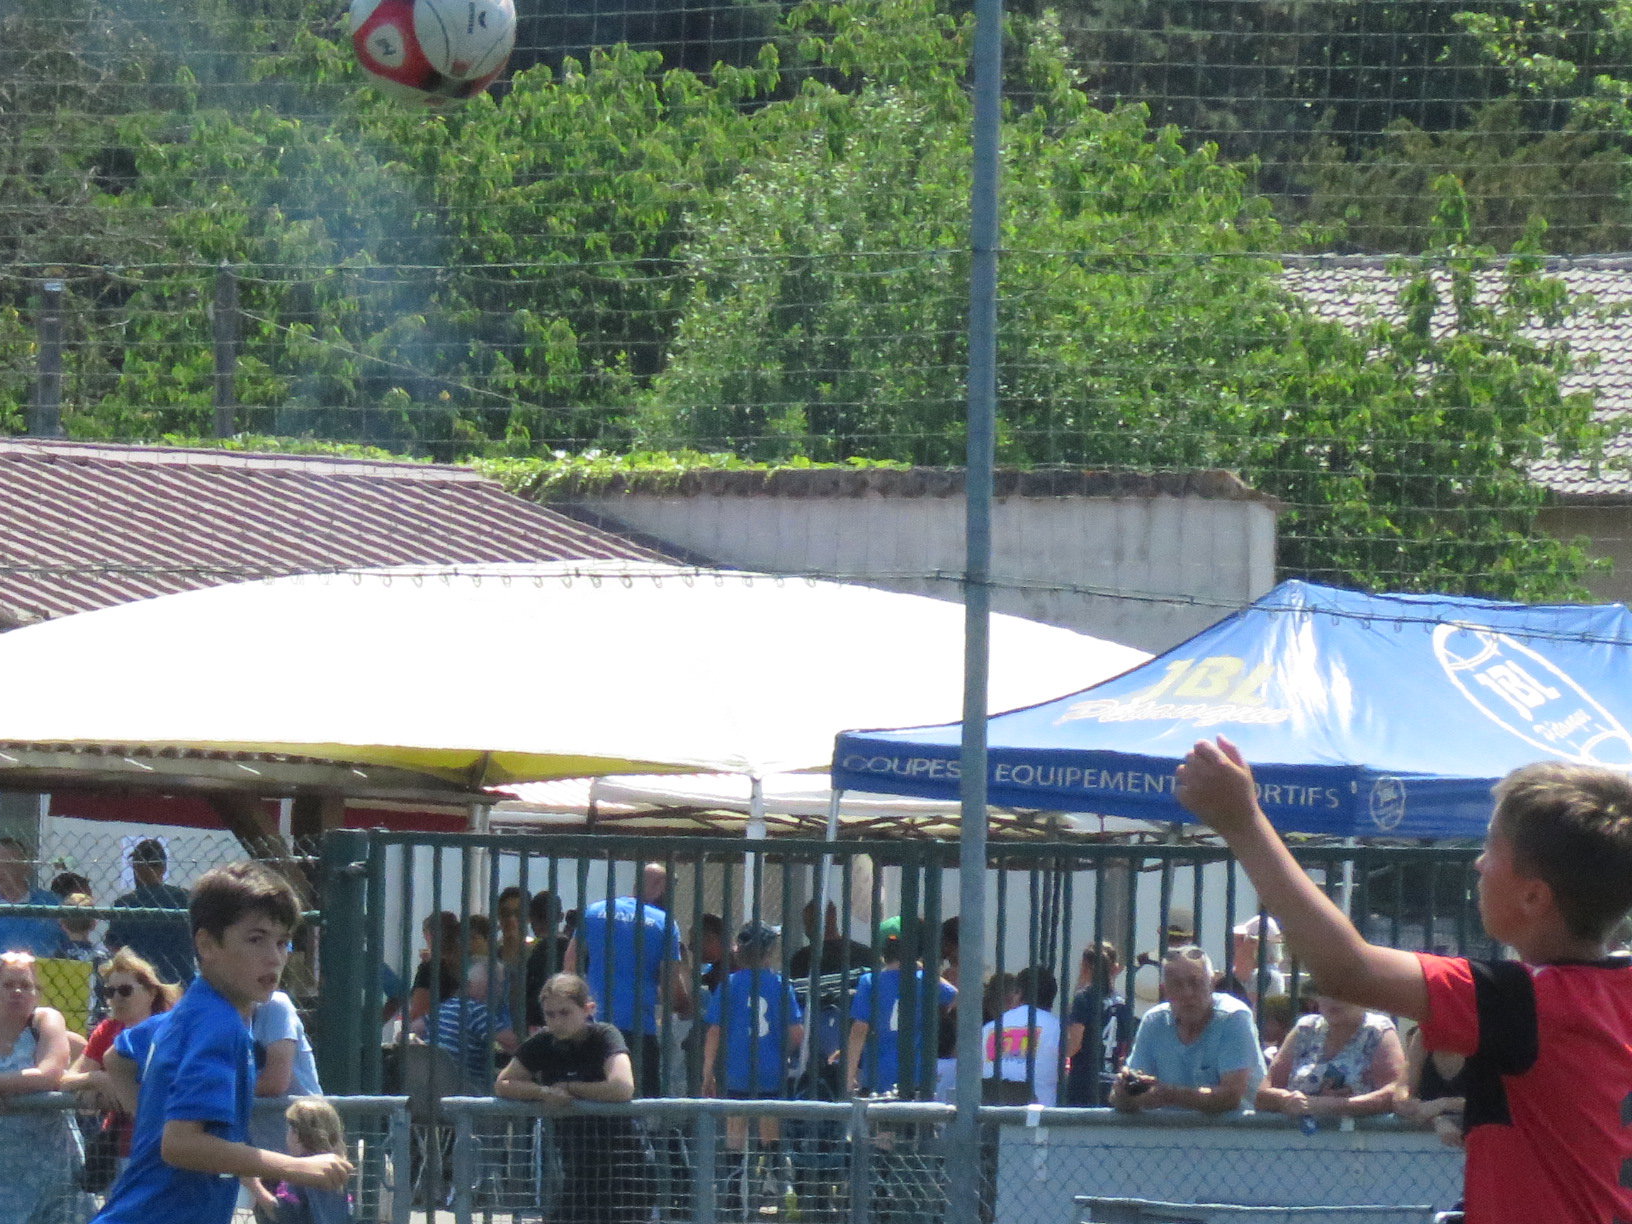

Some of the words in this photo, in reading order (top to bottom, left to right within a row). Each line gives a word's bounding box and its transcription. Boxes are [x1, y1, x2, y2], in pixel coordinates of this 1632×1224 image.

[1116, 655, 1275, 705] JBL
[1472, 659, 1562, 722] JBL
[842, 754, 961, 780] COUPES
[994, 762, 1178, 795] EQUIPEMENT
